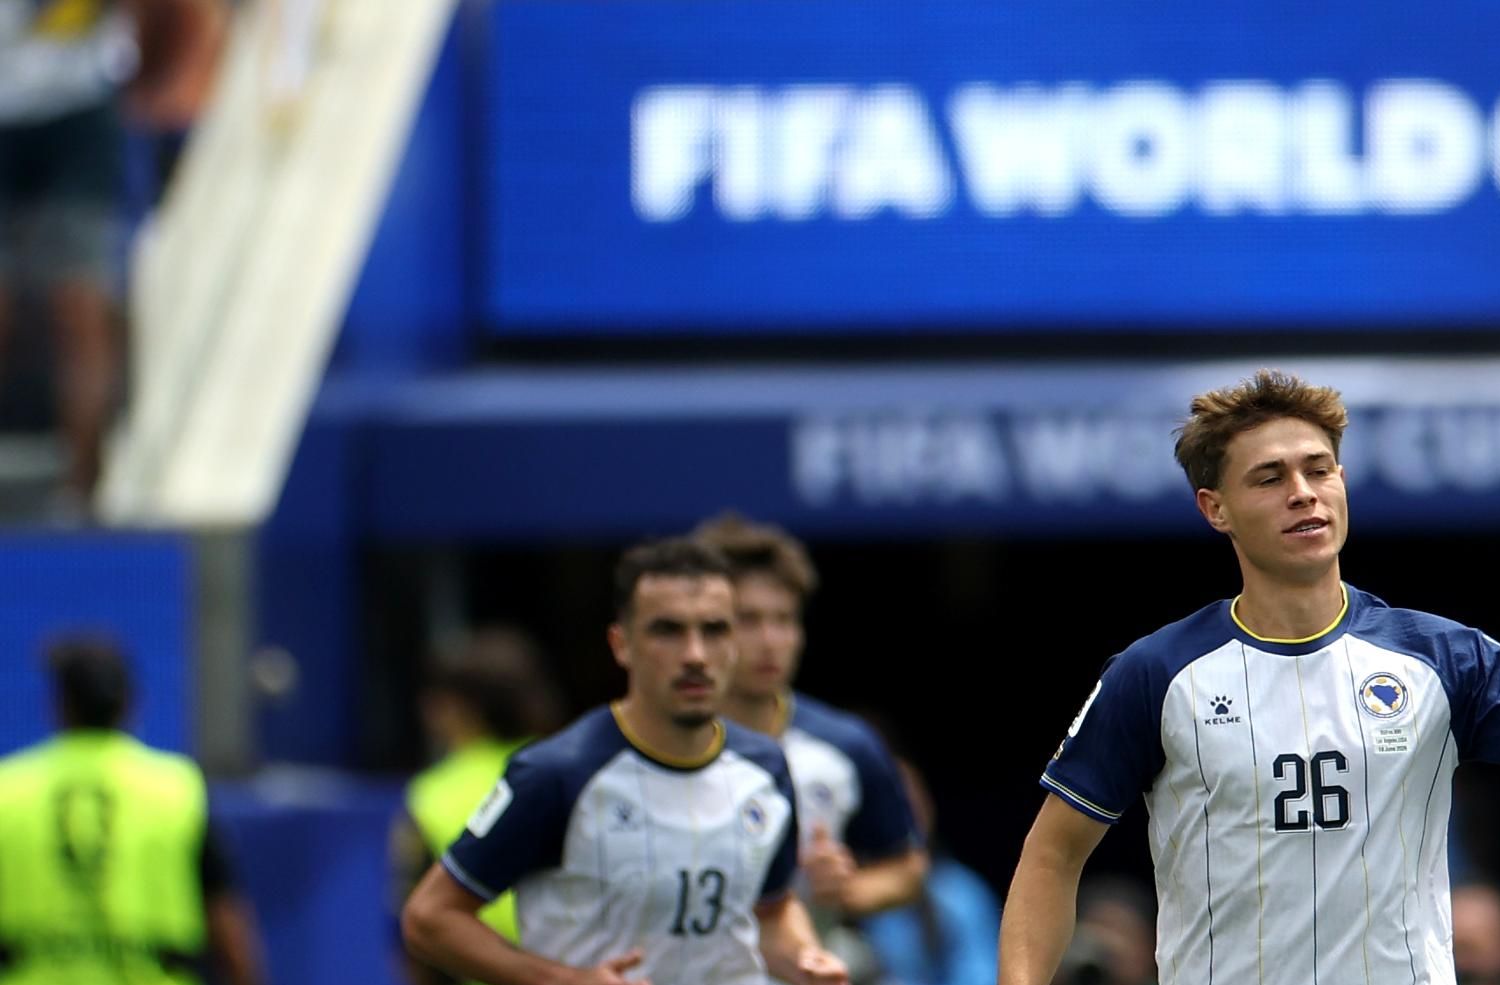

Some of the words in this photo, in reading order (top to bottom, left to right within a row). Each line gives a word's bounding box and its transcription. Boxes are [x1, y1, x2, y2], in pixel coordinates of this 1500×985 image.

[632, 82, 951, 222] FIFA
[951, 77, 1486, 217] WORLD
[792, 411, 1007, 503] FIFA
[1205, 716, 1241, 726] KELME
[1272, 751, 1351, 833] 26
[669, 869, 726, 938] 13
